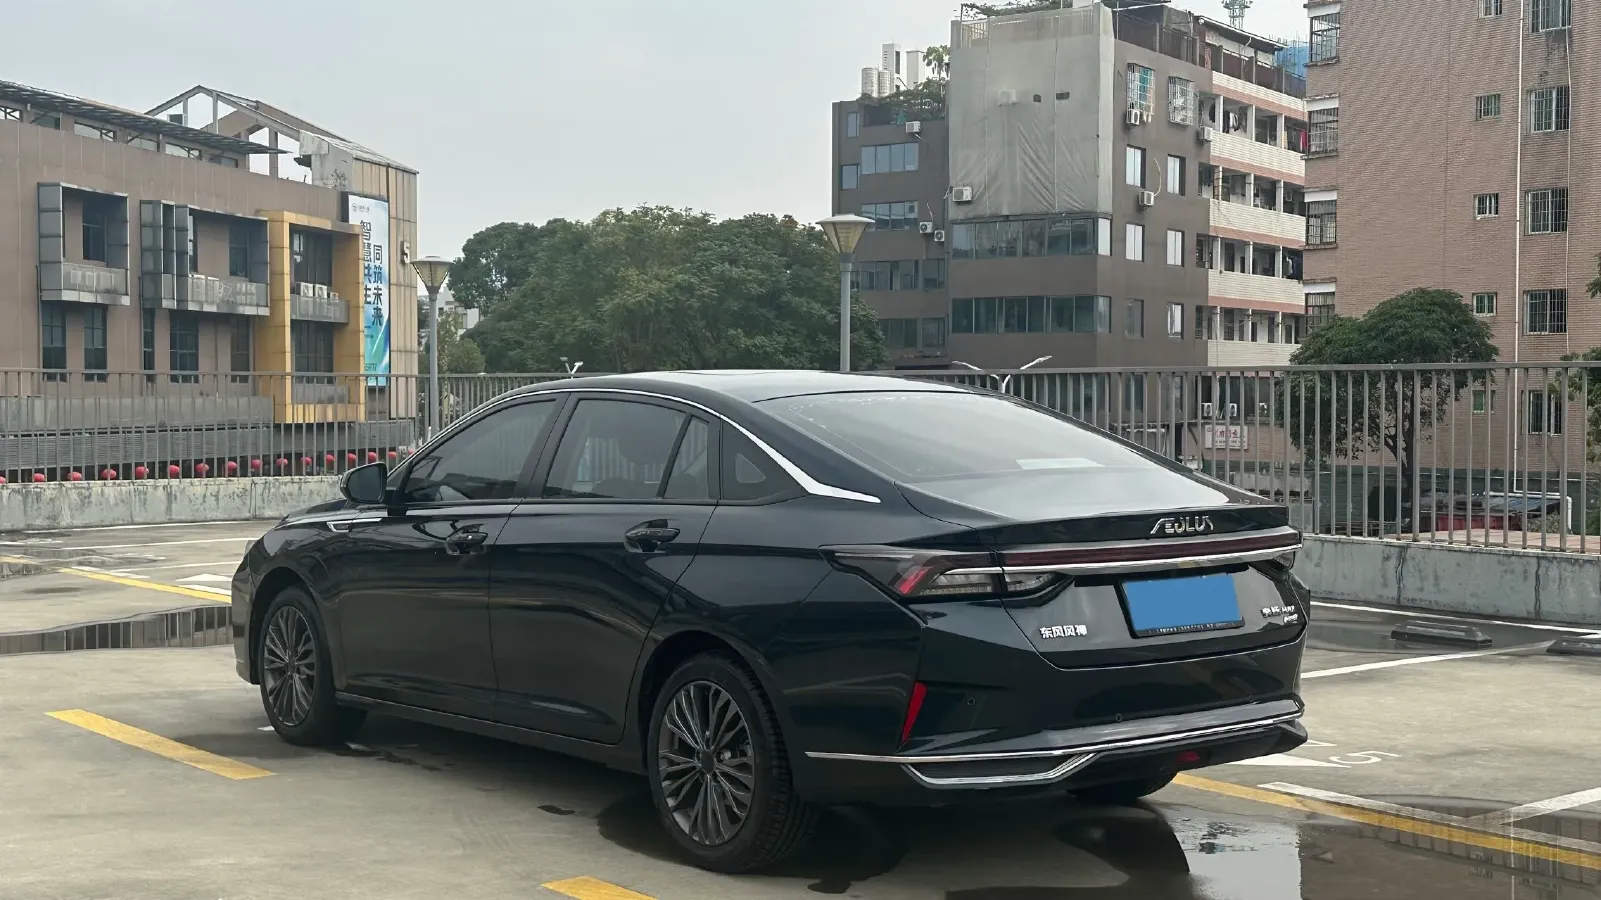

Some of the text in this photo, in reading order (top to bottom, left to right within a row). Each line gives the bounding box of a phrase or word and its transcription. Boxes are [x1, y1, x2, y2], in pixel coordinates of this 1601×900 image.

[372, 244, 383, 326] 同筑未来
[1040, 625, 1087, 638] 东风风神
